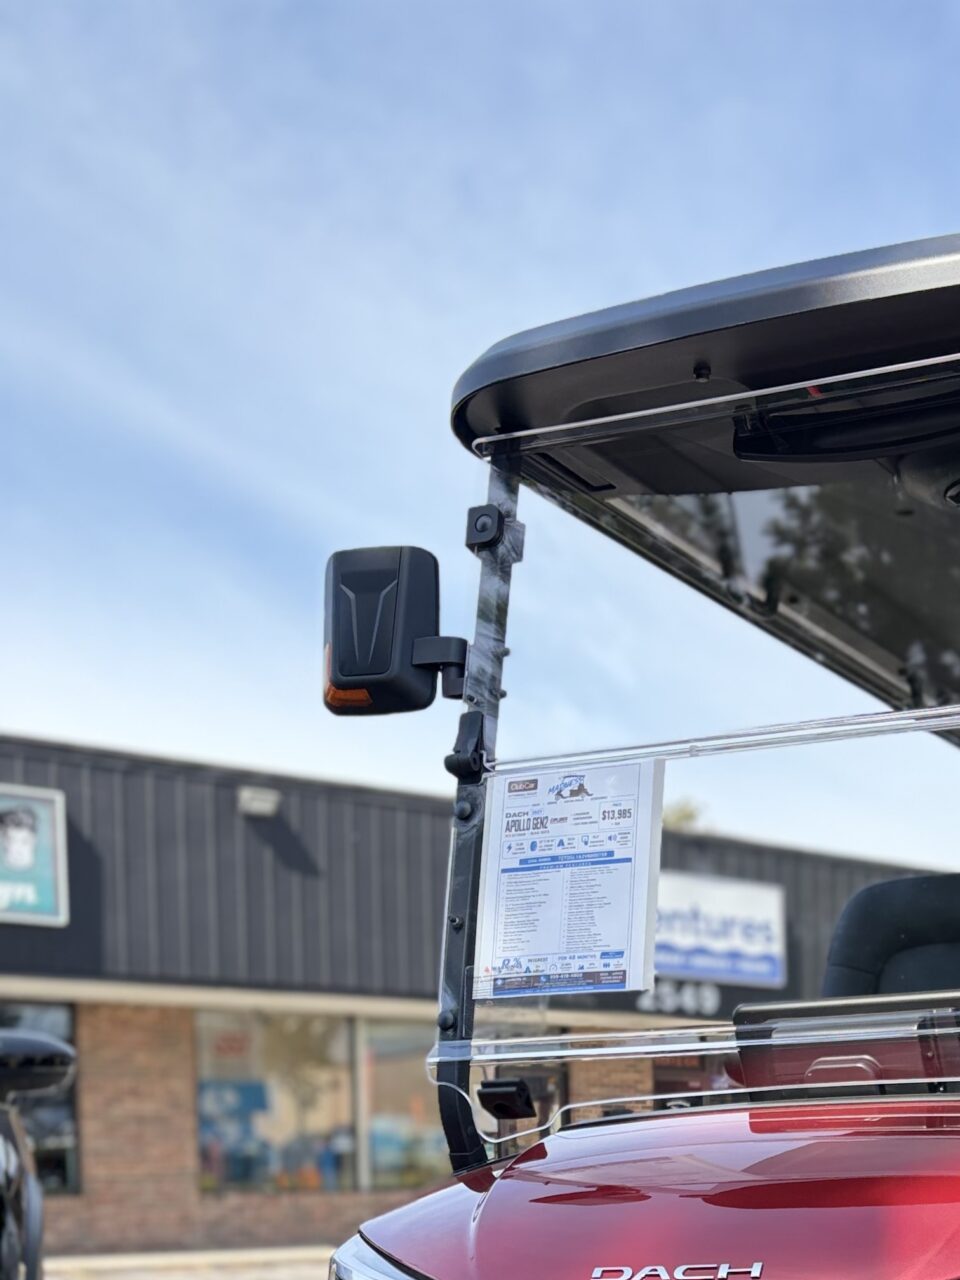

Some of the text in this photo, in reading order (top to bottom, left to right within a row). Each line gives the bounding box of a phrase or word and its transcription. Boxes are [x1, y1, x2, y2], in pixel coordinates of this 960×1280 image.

[505, 811, 529, 819] DACH
[601, 808, 632, 821] $13,985
[505, 818, 531, 833] APOLLO
[532, 816, 549, 830] GEN2
